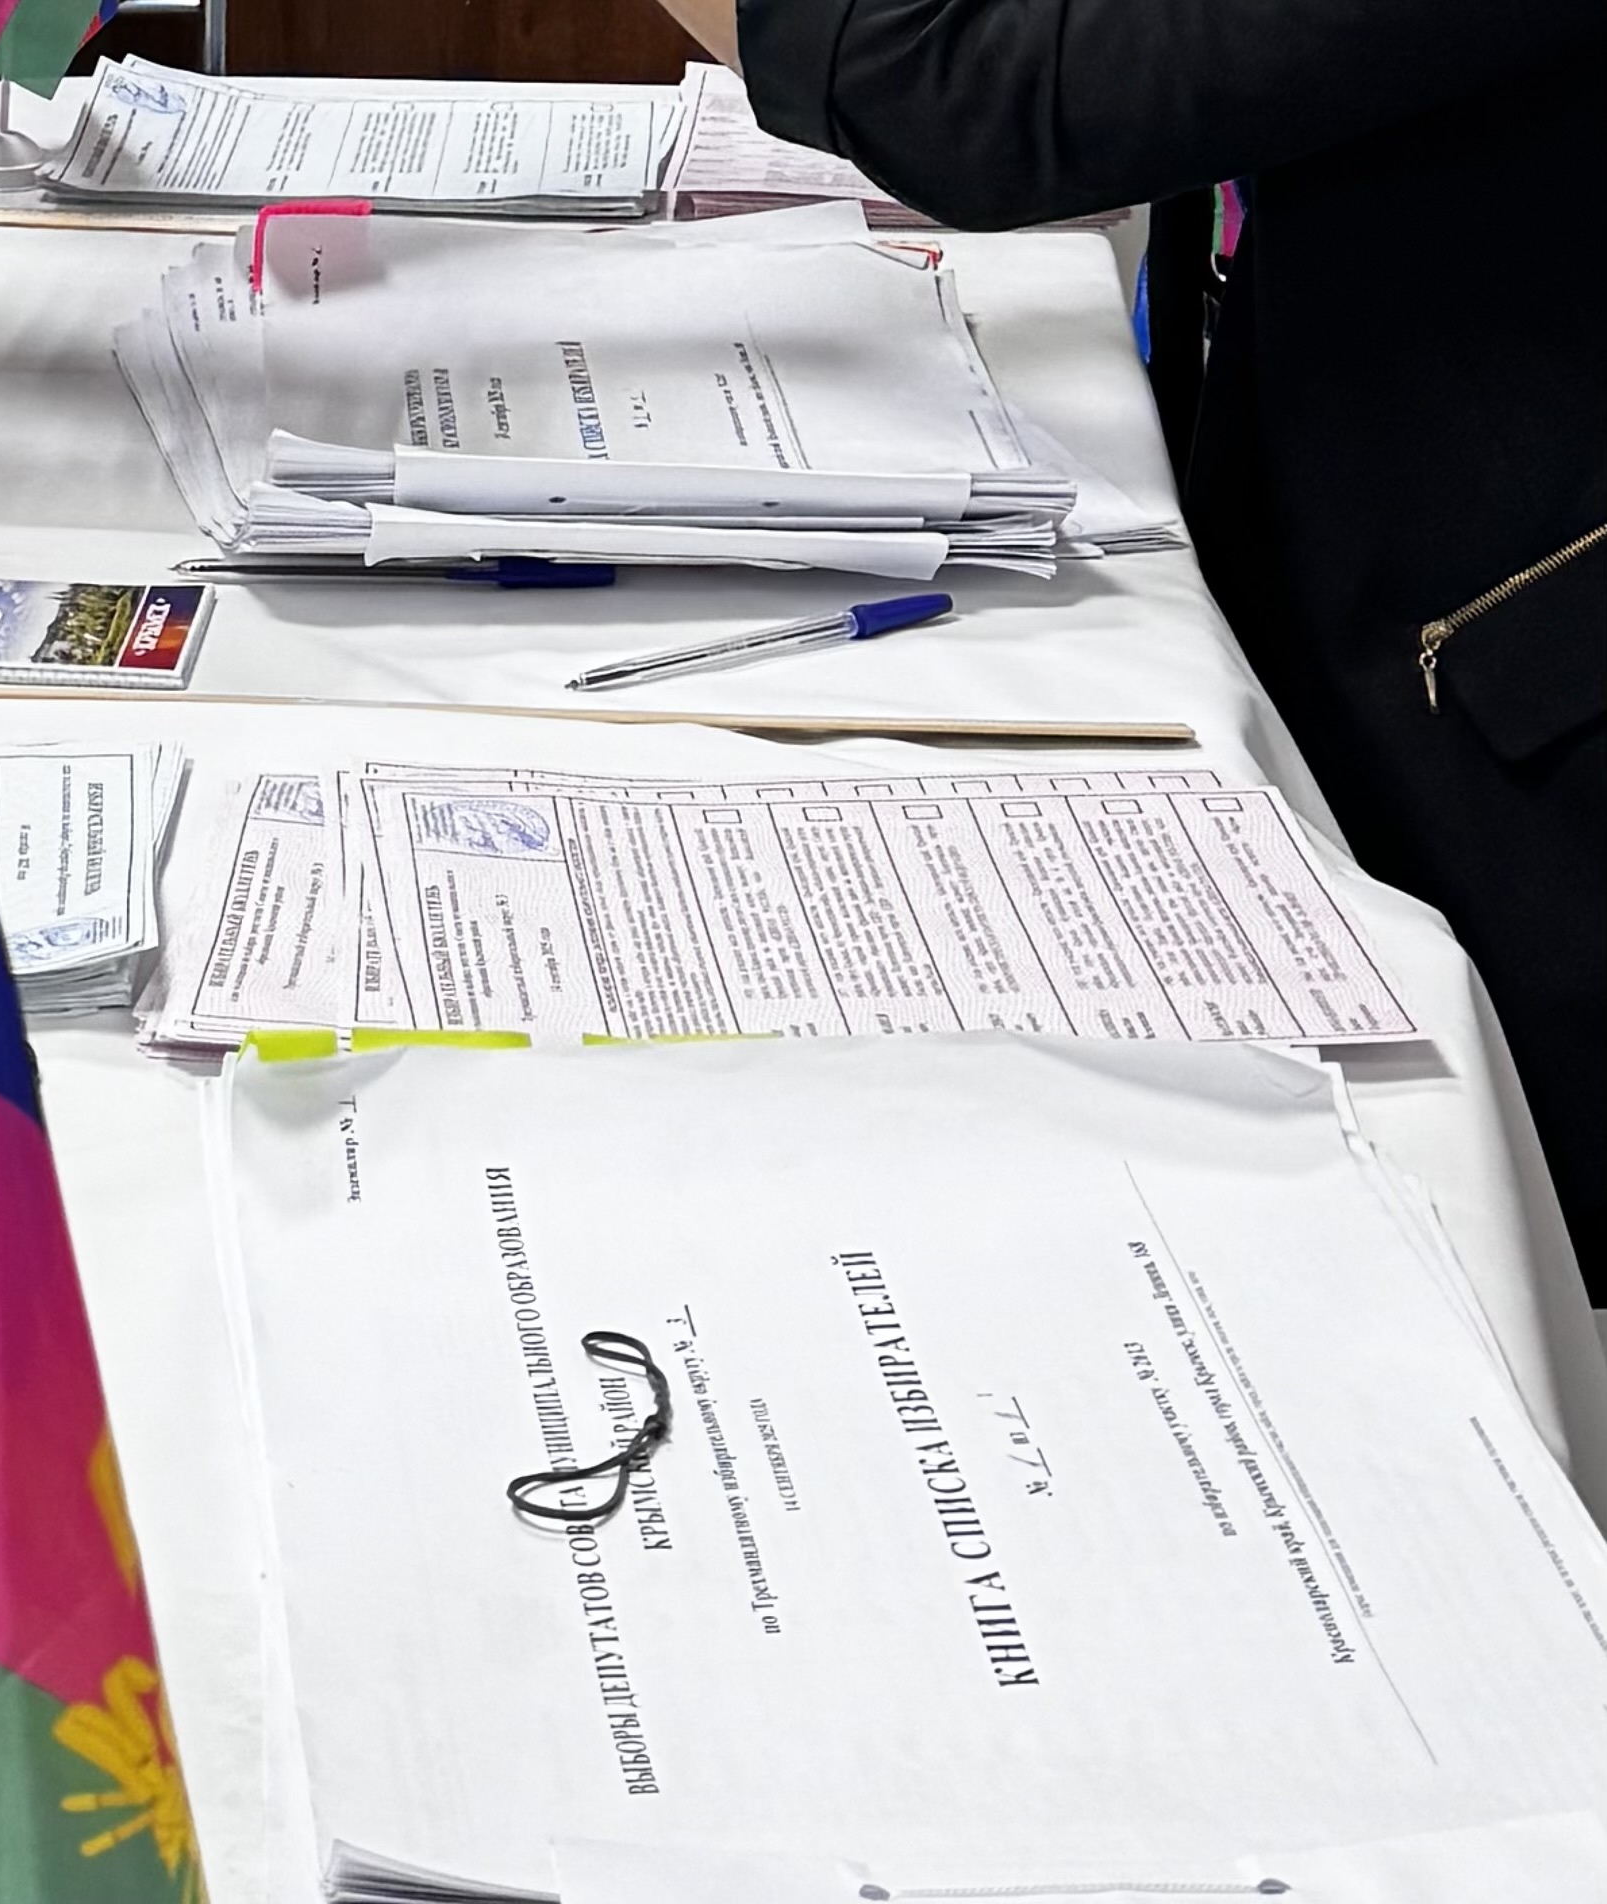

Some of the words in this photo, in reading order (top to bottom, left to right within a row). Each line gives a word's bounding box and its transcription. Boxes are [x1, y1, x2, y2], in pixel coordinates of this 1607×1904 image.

[485, 1166, 538, 1305] ОБРАЗОВАНИЯ
[830, 1250, 943, 1433] ИЗБИРАТЕЛЕЙ
[597, 1376, 639, 1433] РАЙОН
[696, 1398, 738, 1490] избирательному
[558, 1485, 602, 1566] СОВТА
[728, 1496, 778, 1612] Трехмандатному
[914, 1440, 994, 1560] СПИСКА
[577, 1572, 642, 1708] ДЕПУТАТОВ
[762, 1616, 782, 1634] по
[963, 1570, 1041, 1687] КНИГА
[606, 1713, 660, 1795] ВЫБОРЫ
